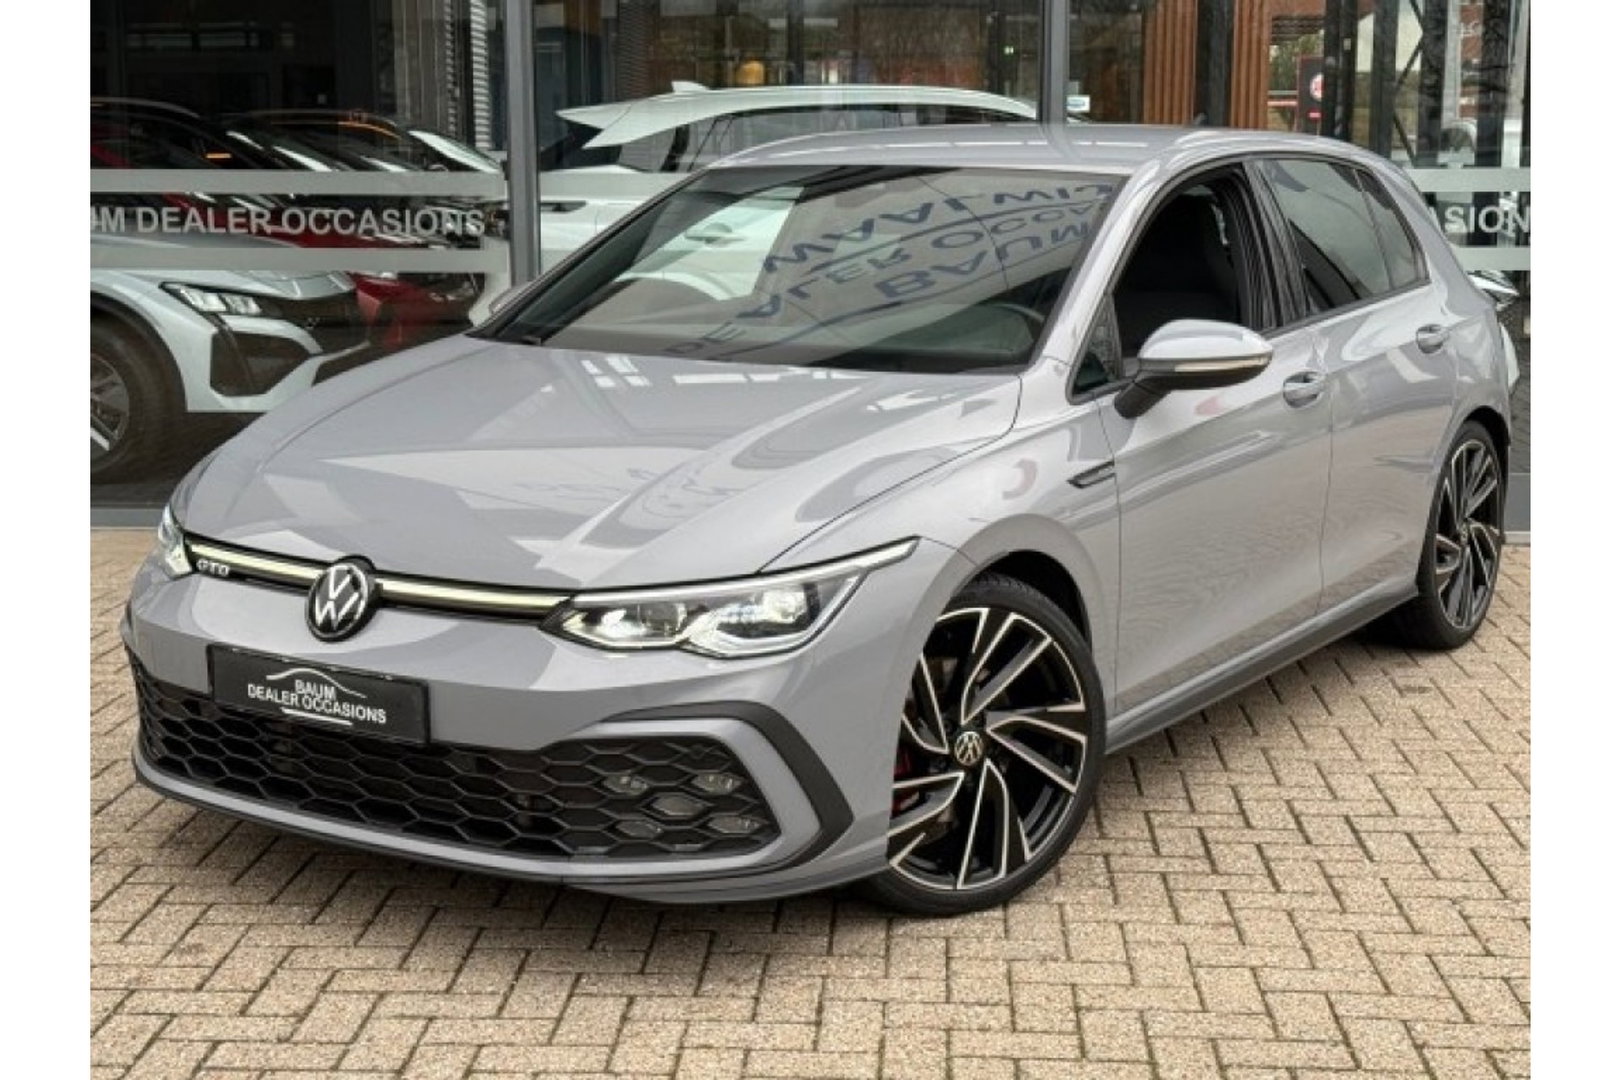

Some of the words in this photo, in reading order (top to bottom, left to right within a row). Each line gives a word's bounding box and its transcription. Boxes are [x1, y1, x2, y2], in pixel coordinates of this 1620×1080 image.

[91, 206, 126, 233] M
[136, 206, 270, 234] DEALER
[281, 207, 485, 236] OCCASIONS
[247, 683, 299, 707] DEALER
[302, 694, 387, 724] OCCASIONS
[295, 679, 336, 701] BAUM
